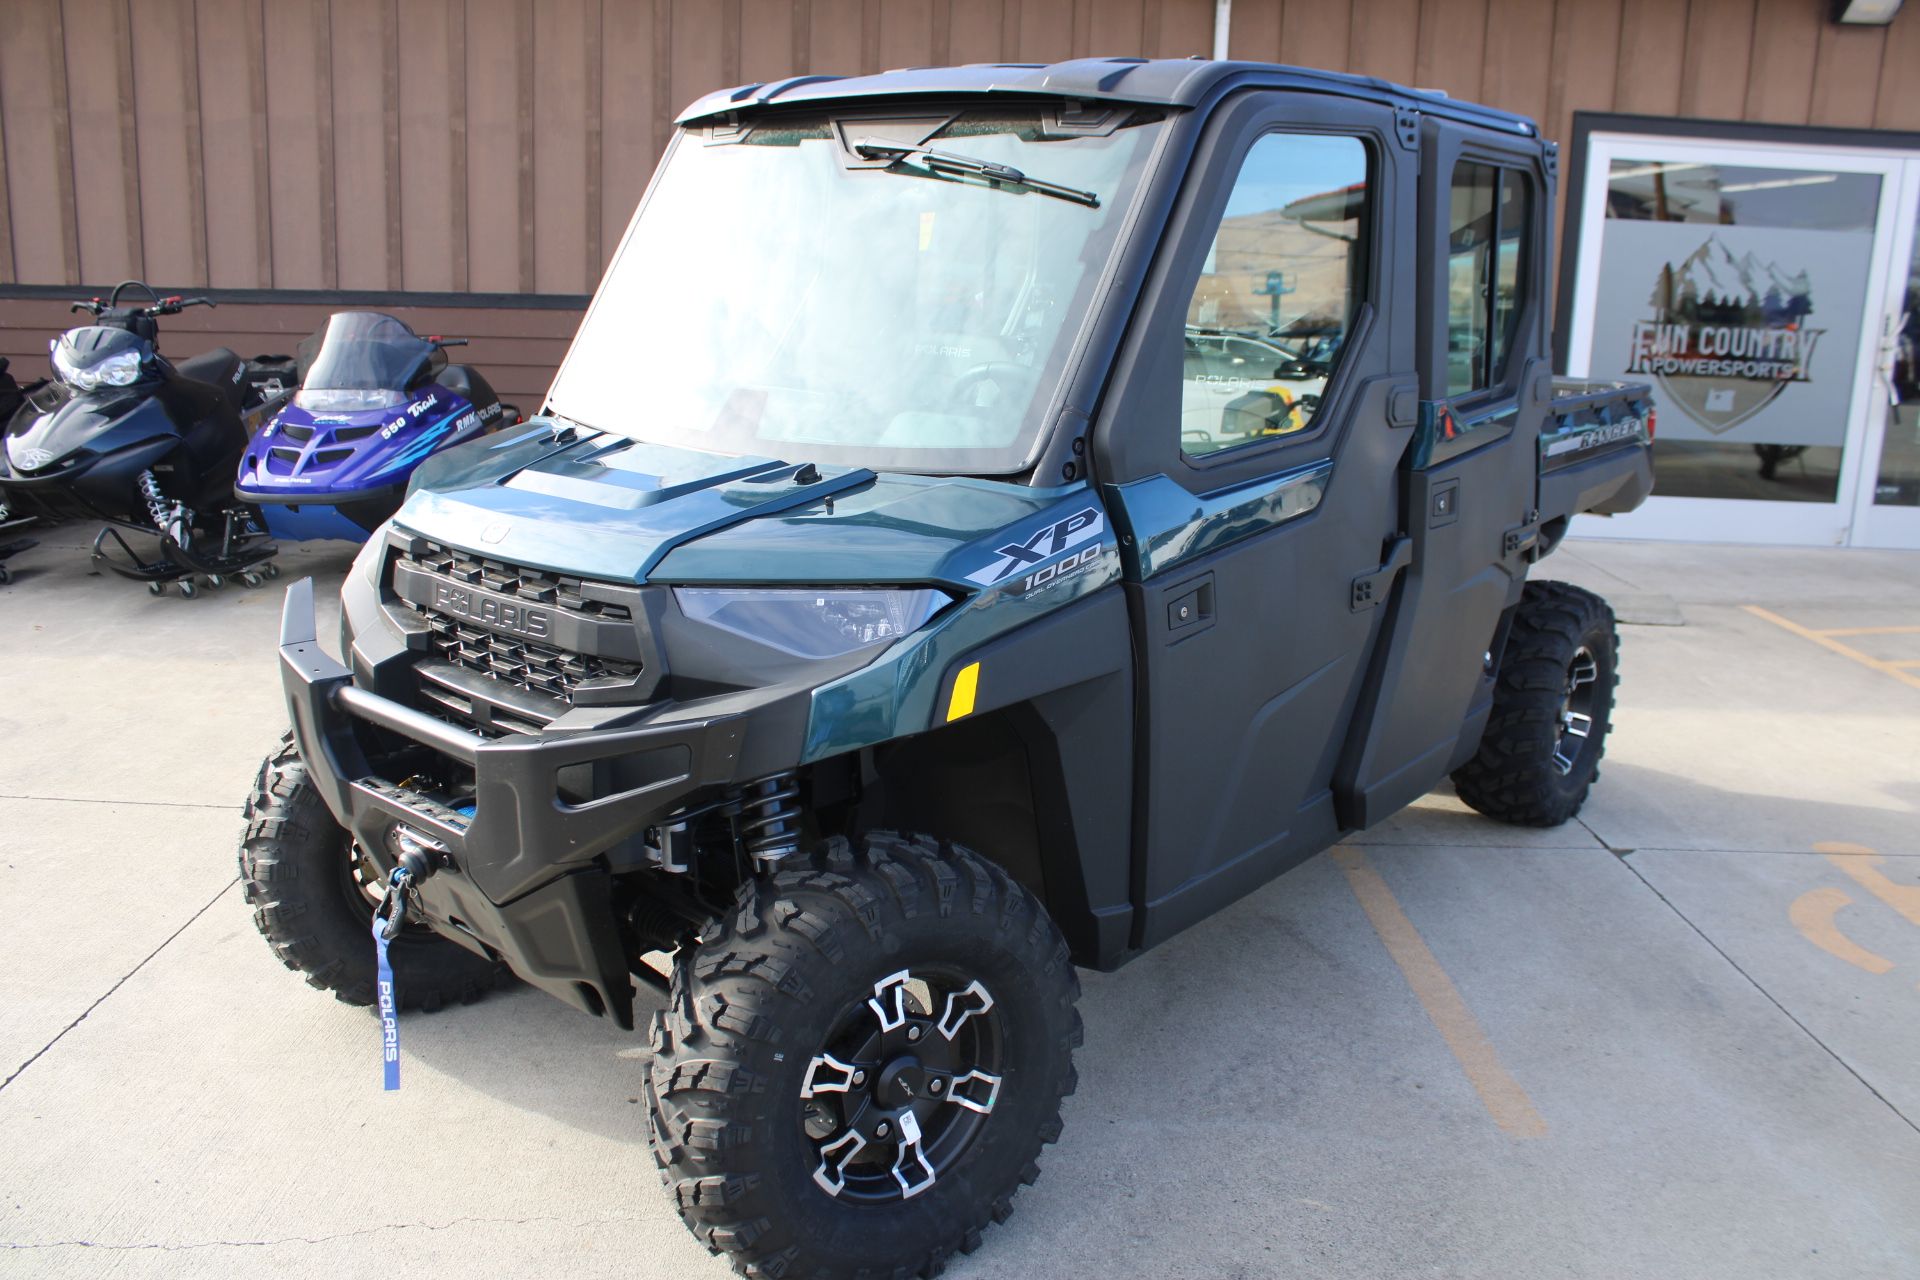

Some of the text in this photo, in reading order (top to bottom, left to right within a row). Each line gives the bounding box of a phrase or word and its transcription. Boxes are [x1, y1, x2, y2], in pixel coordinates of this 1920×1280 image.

[1651, 358, 1794, 379] POWERSPORTS
[1699, 325, 1827, 382] COUNTRY
[381, 393, 438, 440] 550 Trail
[455, 411, 475, 433] RMK
[1578, 419, 1640, 451] RANGER
[990, 506, 1100, 584] XP
[1024, 542, 1102, 591] 1000
[435, 582, 549, 638] POLARIS
[379, 981, 398, 1063] POLARIS
